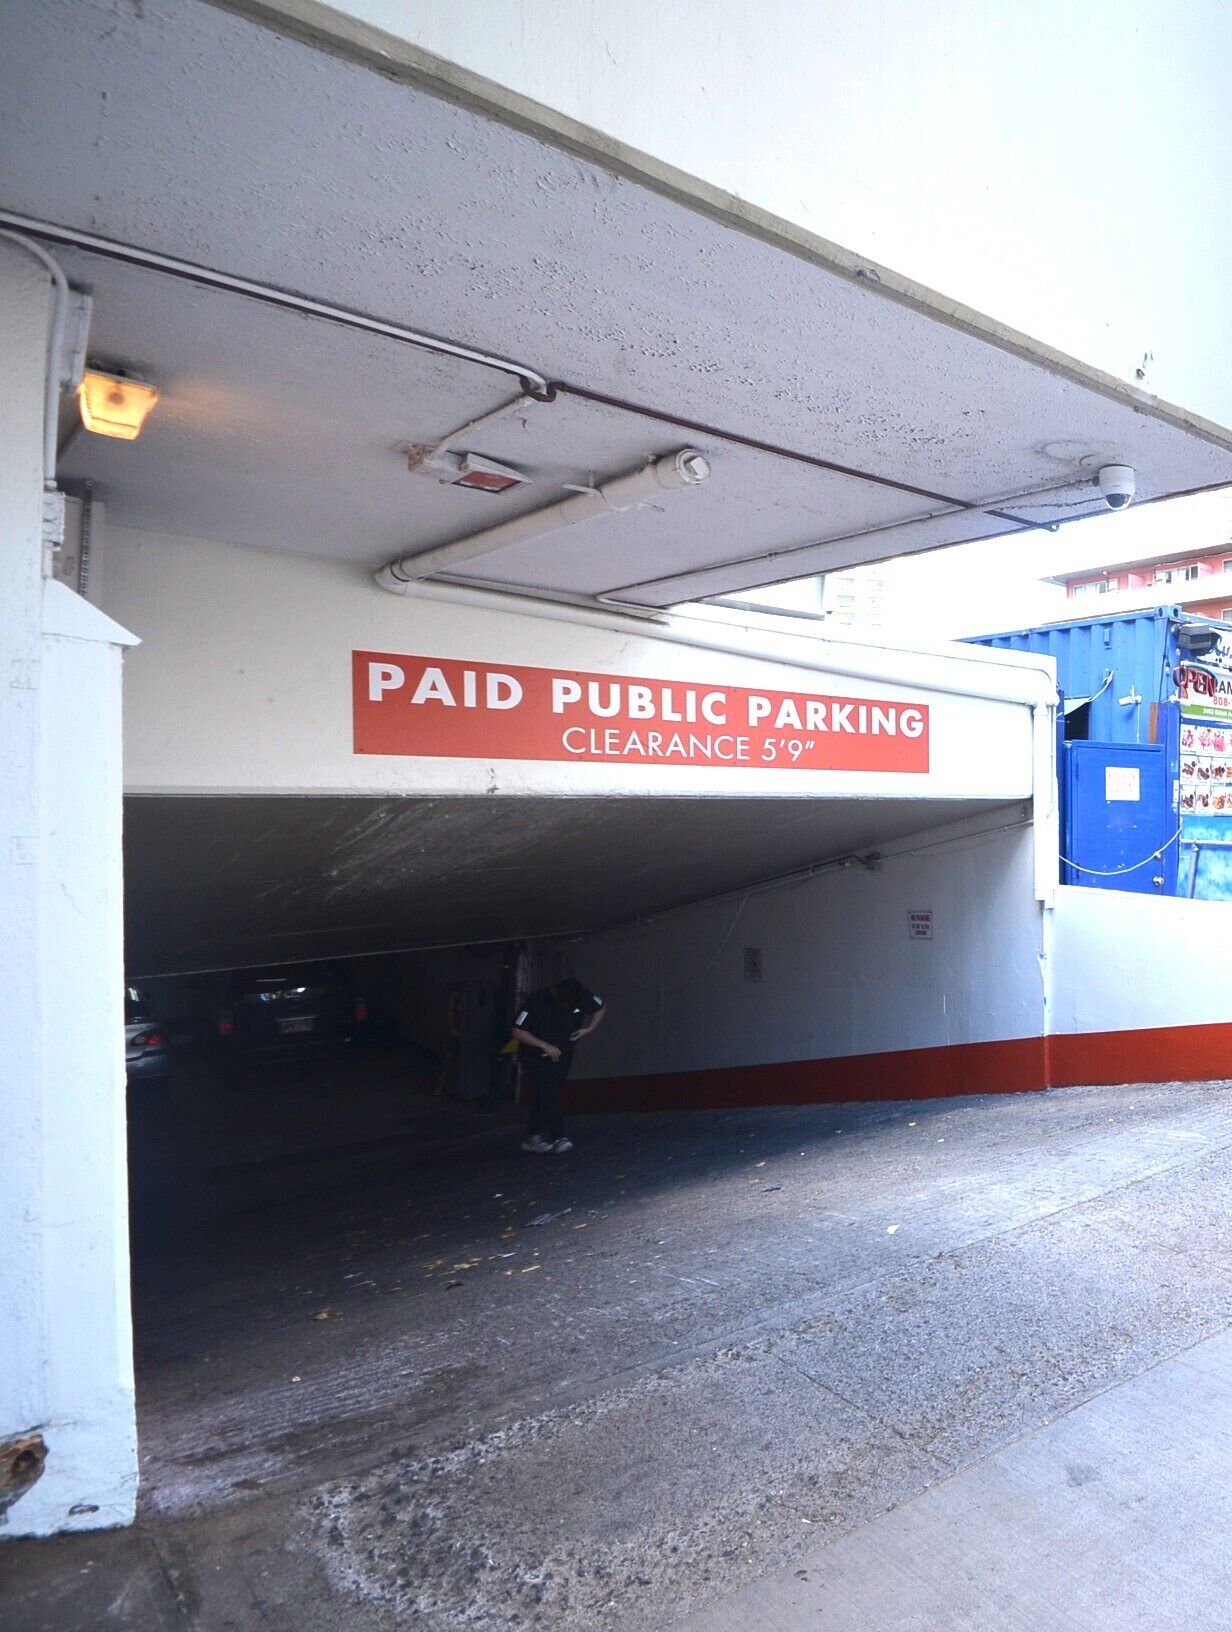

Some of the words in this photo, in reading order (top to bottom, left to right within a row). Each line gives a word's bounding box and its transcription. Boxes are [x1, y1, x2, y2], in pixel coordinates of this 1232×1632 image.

[367, 661, 523, 711] PAID
[551, 678, 727, 726] PUBLIC
[747, 695, 925, 739] PARKING
[561, 726, 750, 761] CLEARANCE
